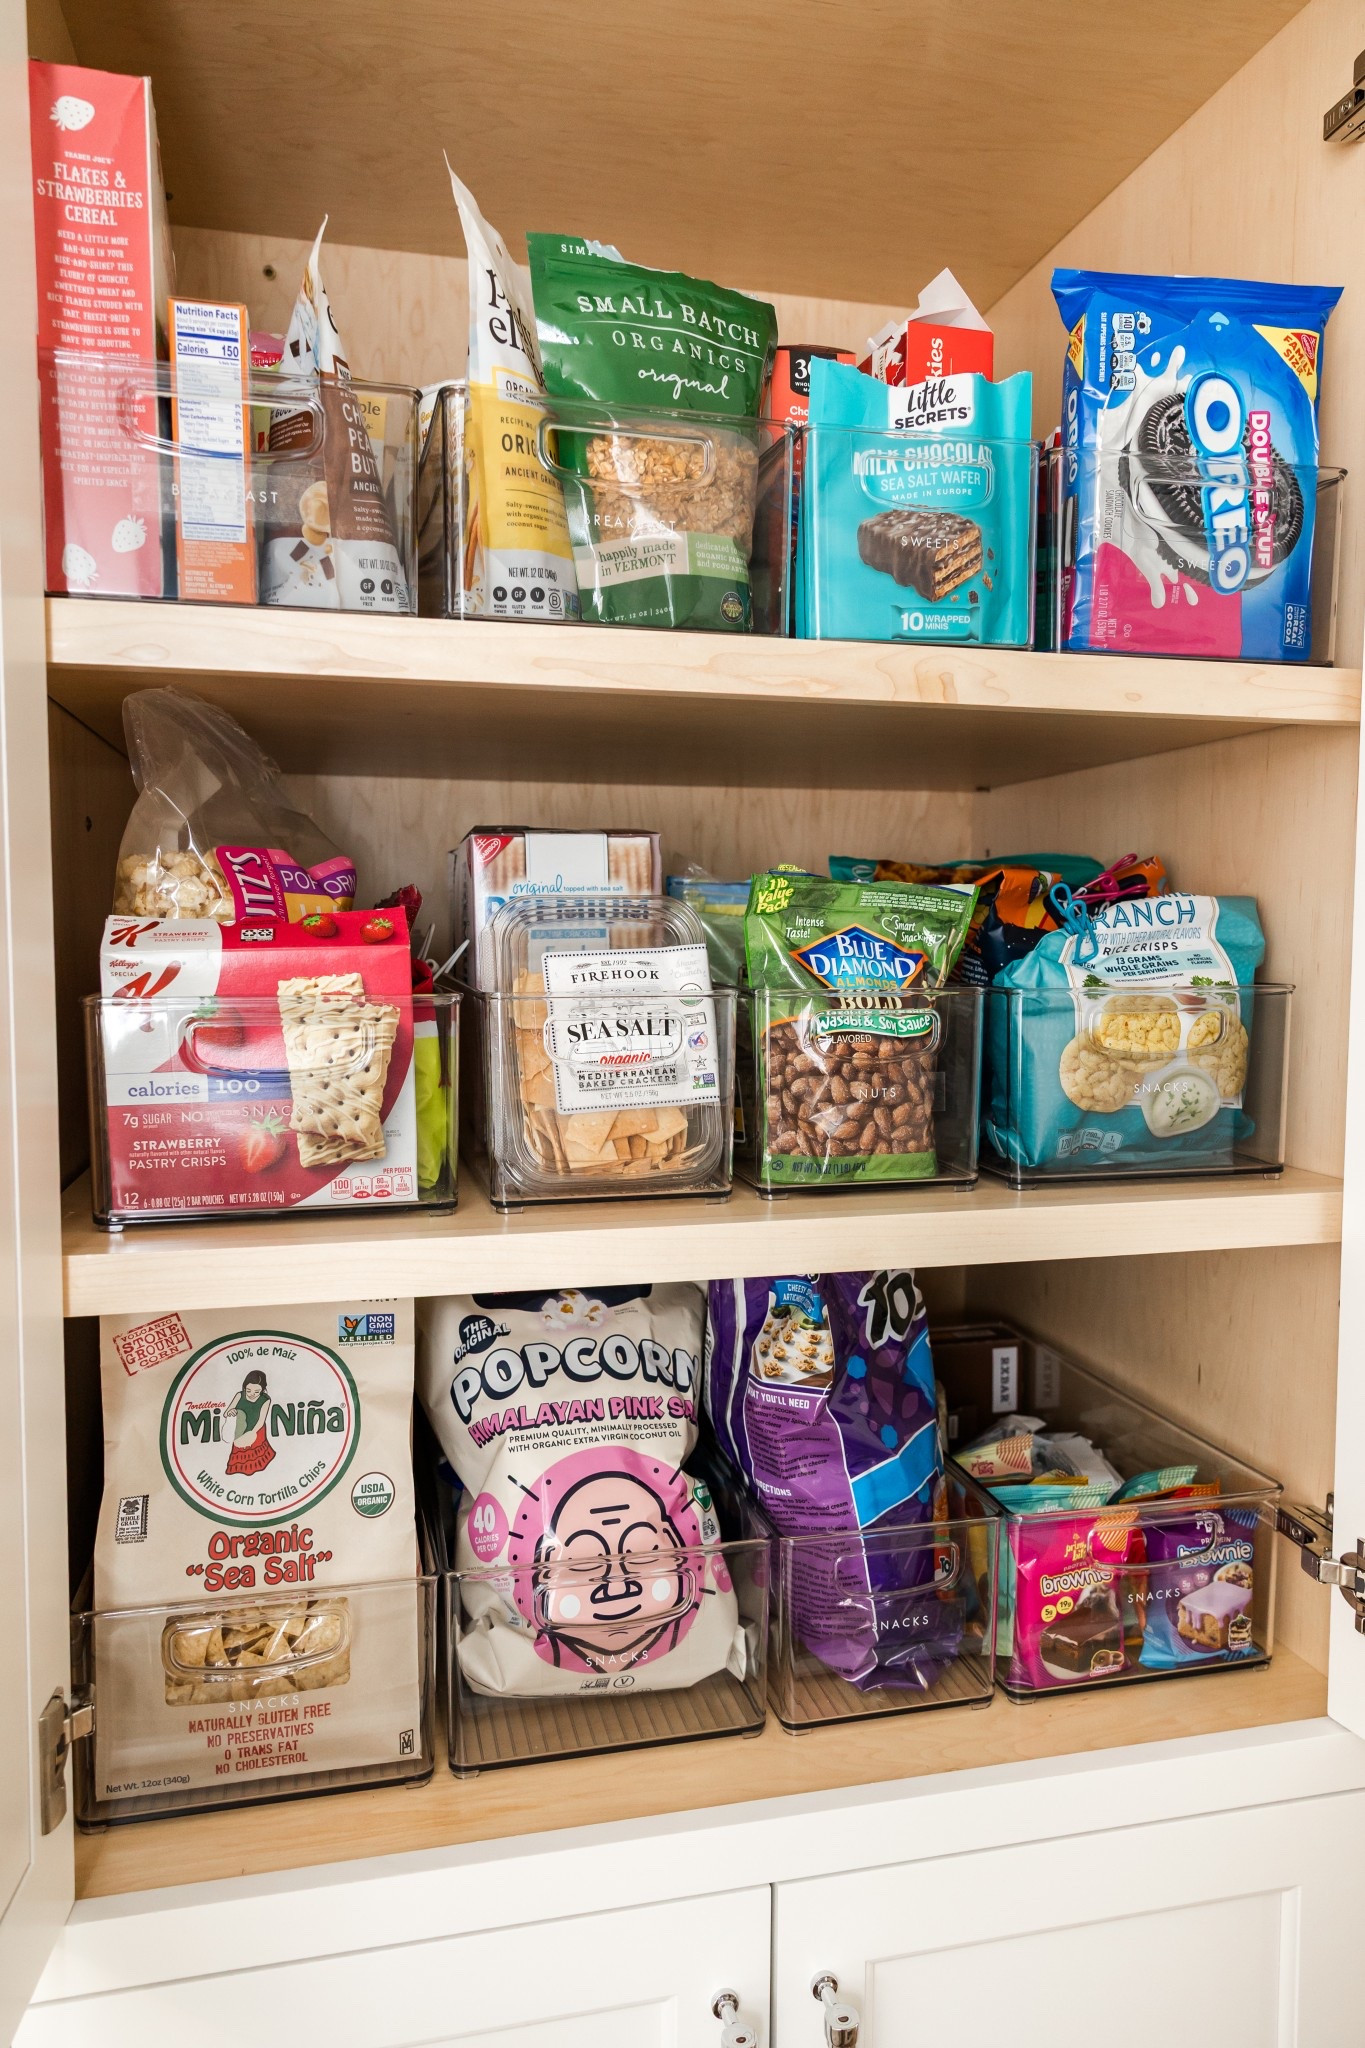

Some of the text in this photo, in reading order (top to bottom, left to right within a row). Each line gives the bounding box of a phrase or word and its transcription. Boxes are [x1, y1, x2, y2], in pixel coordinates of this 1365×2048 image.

[53, 162, 126, 189] FLAKES &
[37, 179, 143, 208] STRAWBERRIES
[64, 205, 118, 226] CEREAL
[176, 305, 238, 320] Nutrition Facts
[577, 296, 760, 348] SMALL BATCH
[1123, 316, 1132, 329] 140
[177, 343, 239, 358] Calories 150
[612, 330, 746, 373] ORGANICS
[638, 369, 730, 400] original
[907, 379, 957, 413] Little
[894, 407, 968, 430] SECRETS
[881, 471, 981, 491] SEA SALT WAFER
[1193, 377, 1249, 590] OREO
[1250, 413, 1272, 566] DOUBLE STUF
[598, 541, 676, 563] happily made
[901, 535, 960, 550] SWEETS
[601, 553, 677, 577] in VERMONT
[1178, 557, 1233, 571] SWEETS
[900, 612, 971, 631] 10 WRAPPED
[925, 622, 949, 631] MINIS
[1285, 606, 1293, 643] COCOA
[1297, 608, 1306, 646] ALWAYS
[512, 874, 563, 895] original
[758, 887, 794, 903] Value
[756, 900, 789, 914] Pack
[1092, 900, 1197, 930] RANCH
[795, 915, 825, 928] Intense
[895, 920, 916, 931] Smart
[786, 927, 810, 939] Taste!
[835, 934, 886, 961] BLUE
[1103, 941, 1179, 956] RICE CRISPS
[109, 959, 139, 969] Kellogg's
[810, 953, 917, 979] DIAMOND
[1105, 960, 1180, 973] WHOLE GRAINS
[1116, 955, 1163, 965] 13 GRAMS
[571, 969, 660, 984] FIREHOOK
[1138, 967, 1168, 976] SERVING
[837, 976, 898, 990] ALMONDS
[567, 1020, 614, 1044] SEA
[616, 1018, 675, 1037] SALT
[818, 1015, 931, 1036] Wasabi & Soy Sauce
[578, 1067, 676, 1081] MEDITERRANEAN
[579, 1074, 677, 1088] BAKED CRACKERS
[128, 1079, 260, 1097] calories 100
[859, 1087, 896, 1099] NUTS
[1134, 1082, 1188, 1093] SNACKS
[123, 1112, 203, 1128] 7g SUGAR NO
[242, 1105, 314, 1117] SNACKS
[133, 1137, 221, 1151] STRAWBERRY
[129, 1156, 226, 1169] PASTRY CRISPS
[124, 1193, 139, 1205] 12
[787, 1283, 807, 1294] CHEESY
[121, 1319, 172, 1342] VOLCANIC
[122, 1323, 180, 1354] STONE
[463, 1319, 488, 1338] THE
[125, 1333, 185, 1364] GROUND
[454, 1323, 511, 1363] ORIGINAL
[139, 1346, 179, 1366] CORN
[226, 1348, 254, 1365] 100%
[256, 1346, 269, 1356] de
[450, 1334, 699, 1425] POPCORN
[1000, 1357, 1010, 1403] RXBAR
[761, 1392, 786, 1405] YOU'LL
[789, 1398, 810, 1409] NEED
[180, 1400, 345, 1445] Mi Niña
[468, 1398, 604, 1448] HIMALAYAN
[608, 1395, 664, 1420] PINK
[508, 1444, 530, 1453] WITH
[532, 1439, 572, 1450] ORGANIC
[574, 1436, 600, 1445] EXTRA
[601, 1432, 629, 1441] VIRGIN
[630, 1431, 667, 1440] COCONUT
[509, 1422, 678, 1443] PREMIUM QUALITY, MINIMALLY PROCESSED
[196, 1460, 326, 1506] White Corn Tortilla Chips
[360, 1482, 385, 1495] USDA
[356, 1495, 388, 1507] ORGANIC
[473, 1504, 496, 1533] 40
[207, 1524, 314, 1561] Organic
[474, 1533, 499, 1544] CALORIES
[477, 1543, 498, 1553] PER CUP
[1042, 1569, 1113, 1596] brownie
[1127, 1588, 1181, 1603] SNACKS
[872, 1616, 929, 1632] SNACKS
[585, 1650, 649, 1667] SNACKS
[228, 1694, 300, 1714] SNACKS
[188, 1702, 331, 1733] NATURALLY GLUTEN FREE
[207, 1722, 314, 1748] NO PRESERVATIVES
[224, 1740, 299, 1760] 0 TRANS FAT
[215, 1752, 308, 1775] NO CHOLESTEROL
[106, 1773, 190, 1794] Net Wt. 12oz (340g)
